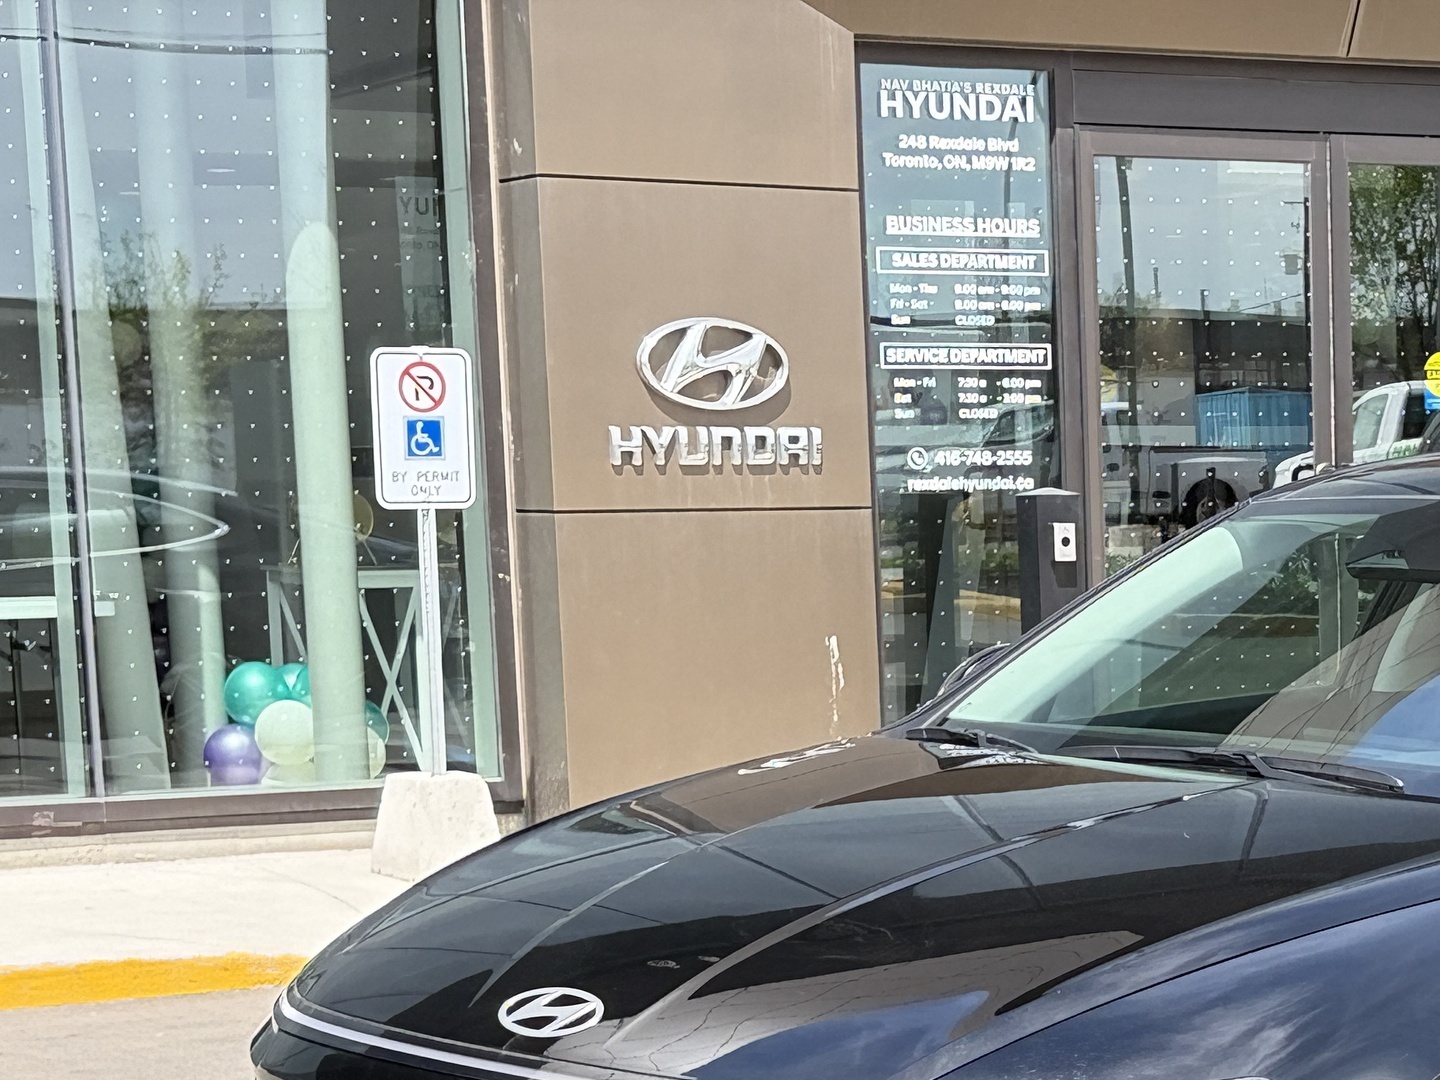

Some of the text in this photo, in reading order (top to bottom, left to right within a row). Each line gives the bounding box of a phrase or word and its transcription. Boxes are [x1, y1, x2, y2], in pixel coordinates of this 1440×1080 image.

[881, 78, 1035, 96] NAV BHATIA'S REXDALE
[880, 90, 1035, 123] HYUNDAI
[898, 134, 1019, 153] 248 Rexdale Blvd
[882, 152, 943, 171] Toronto,
[943, 154, 971, 172] ON,
[972, 155, 1009, 171] M9W
[885, 215, 1041, 235] BUSINESS HOURS
[892, 252, 1037, 270] SALES DEPARTMENT
[955, 315, 995, 326] CLOSED
[886, 347, 1047, 364] SERVICE DEPARTMENT
[959, 408, 999, 419] CLOSED
[608, 425, 823, 466] HYUNDAI
[934, 450, 1033, 467] 416-748-2555
[392, 470, 460, 483] BY PERMIT
[907, 475, 1035, 493] rexdalehyundai.ca
[411, 484, 442, 497] ONLY
